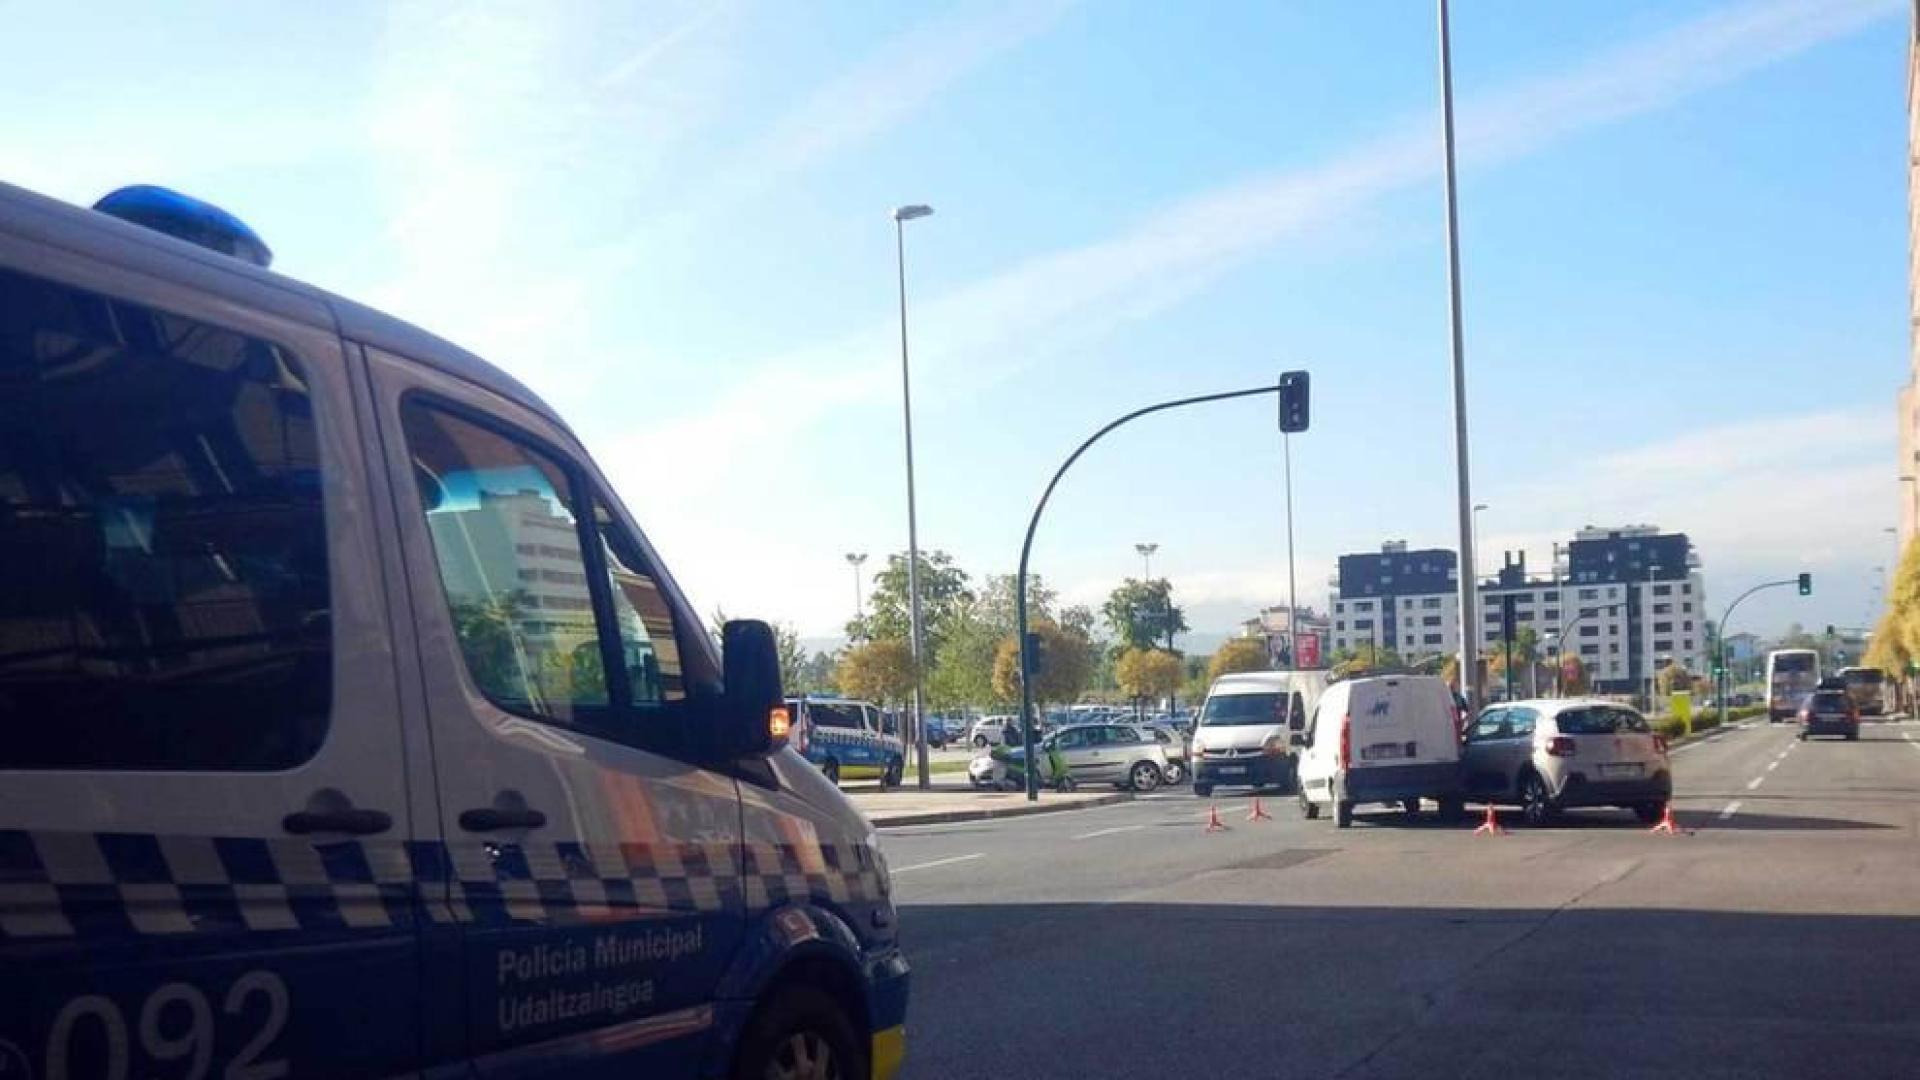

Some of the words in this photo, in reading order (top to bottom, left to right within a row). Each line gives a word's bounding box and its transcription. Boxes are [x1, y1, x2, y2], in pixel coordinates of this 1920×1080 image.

[497, 936, 588, 985] Policía
[593, 919, 704, 968] Municipal
[46, 969, 291, 1080] 092
[497, 977, 654, 1030] Udaltzaingoa
